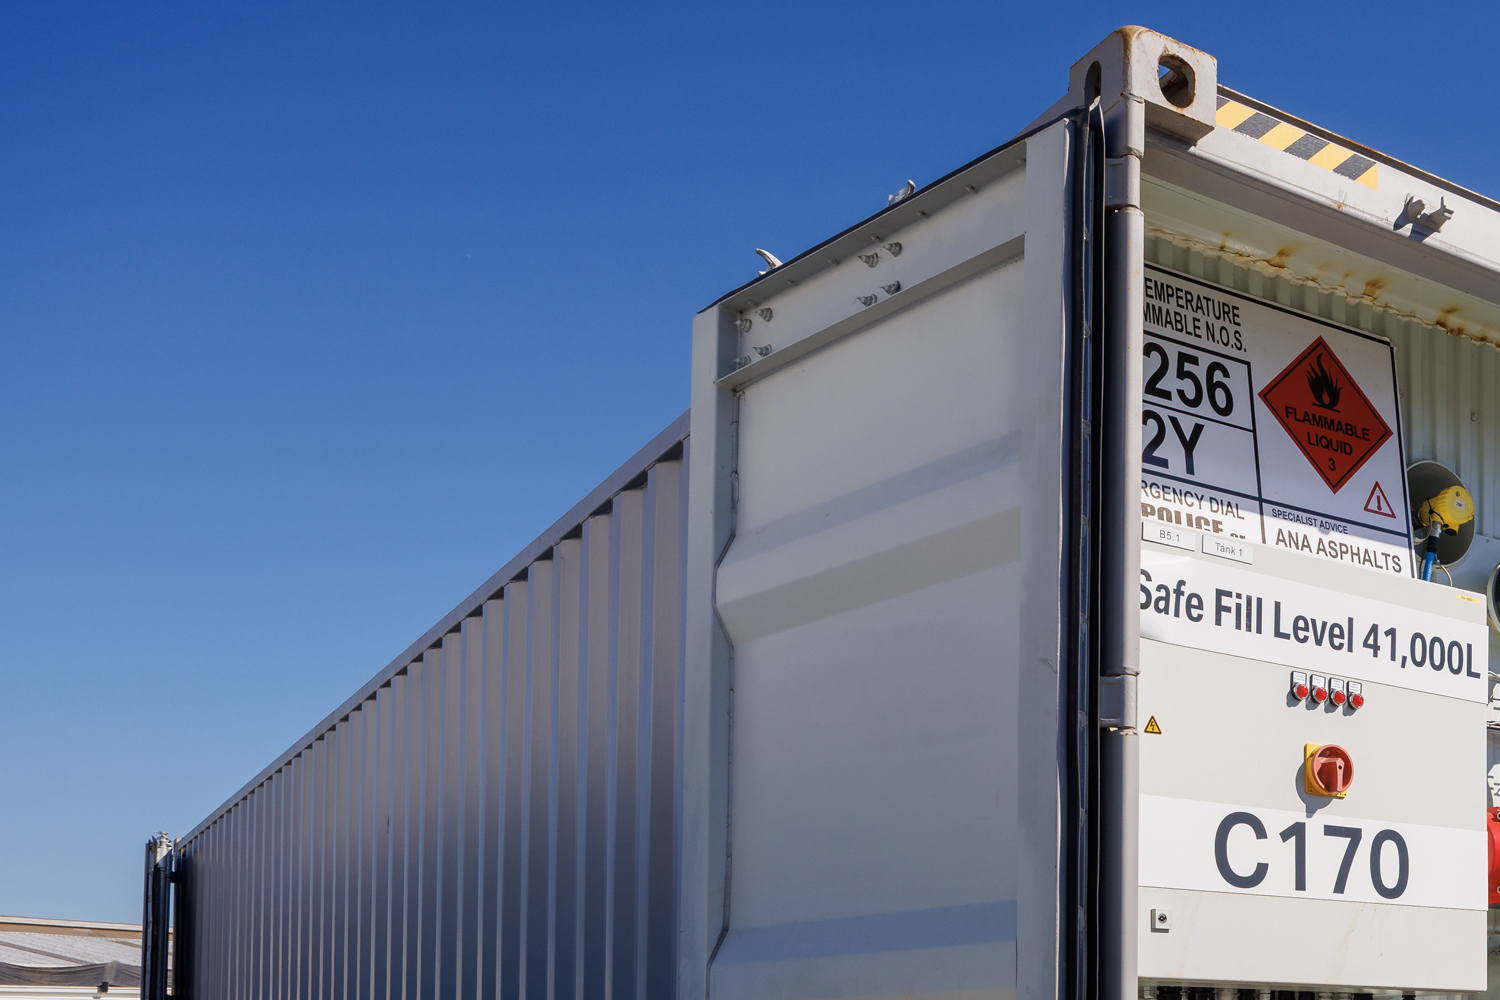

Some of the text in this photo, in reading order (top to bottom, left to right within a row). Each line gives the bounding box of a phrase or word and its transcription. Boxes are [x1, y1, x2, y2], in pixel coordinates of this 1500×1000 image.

[1206, 321, 1246, 352] N.O.S.
[1143, 342, 1233, 417] 256
[1285, 405, 1370, 442] FLAMMABLE
[1142, 409, 1205, 476] 2Y
[1307, 432, 1352, 456] LIQUID
[1328, 457, 1336, 471] 3
[1209, 496, 1245, 520] DIAL
[1271, 508, 1348, 535] SPECIALIST ADVICE
[1159, 529, 1180, 542] B5.1
[1215, 541, 1243, 557] Tank 1
[1275, 528, 1402, 573] ANA ASPHALTS
[1215, 588, 1263, 635] Fill
[1273, 600, 1354, 653] Level
[1362, 623, 1481, 680] 41,000L
[1214, 811, 1409, 900] C170
